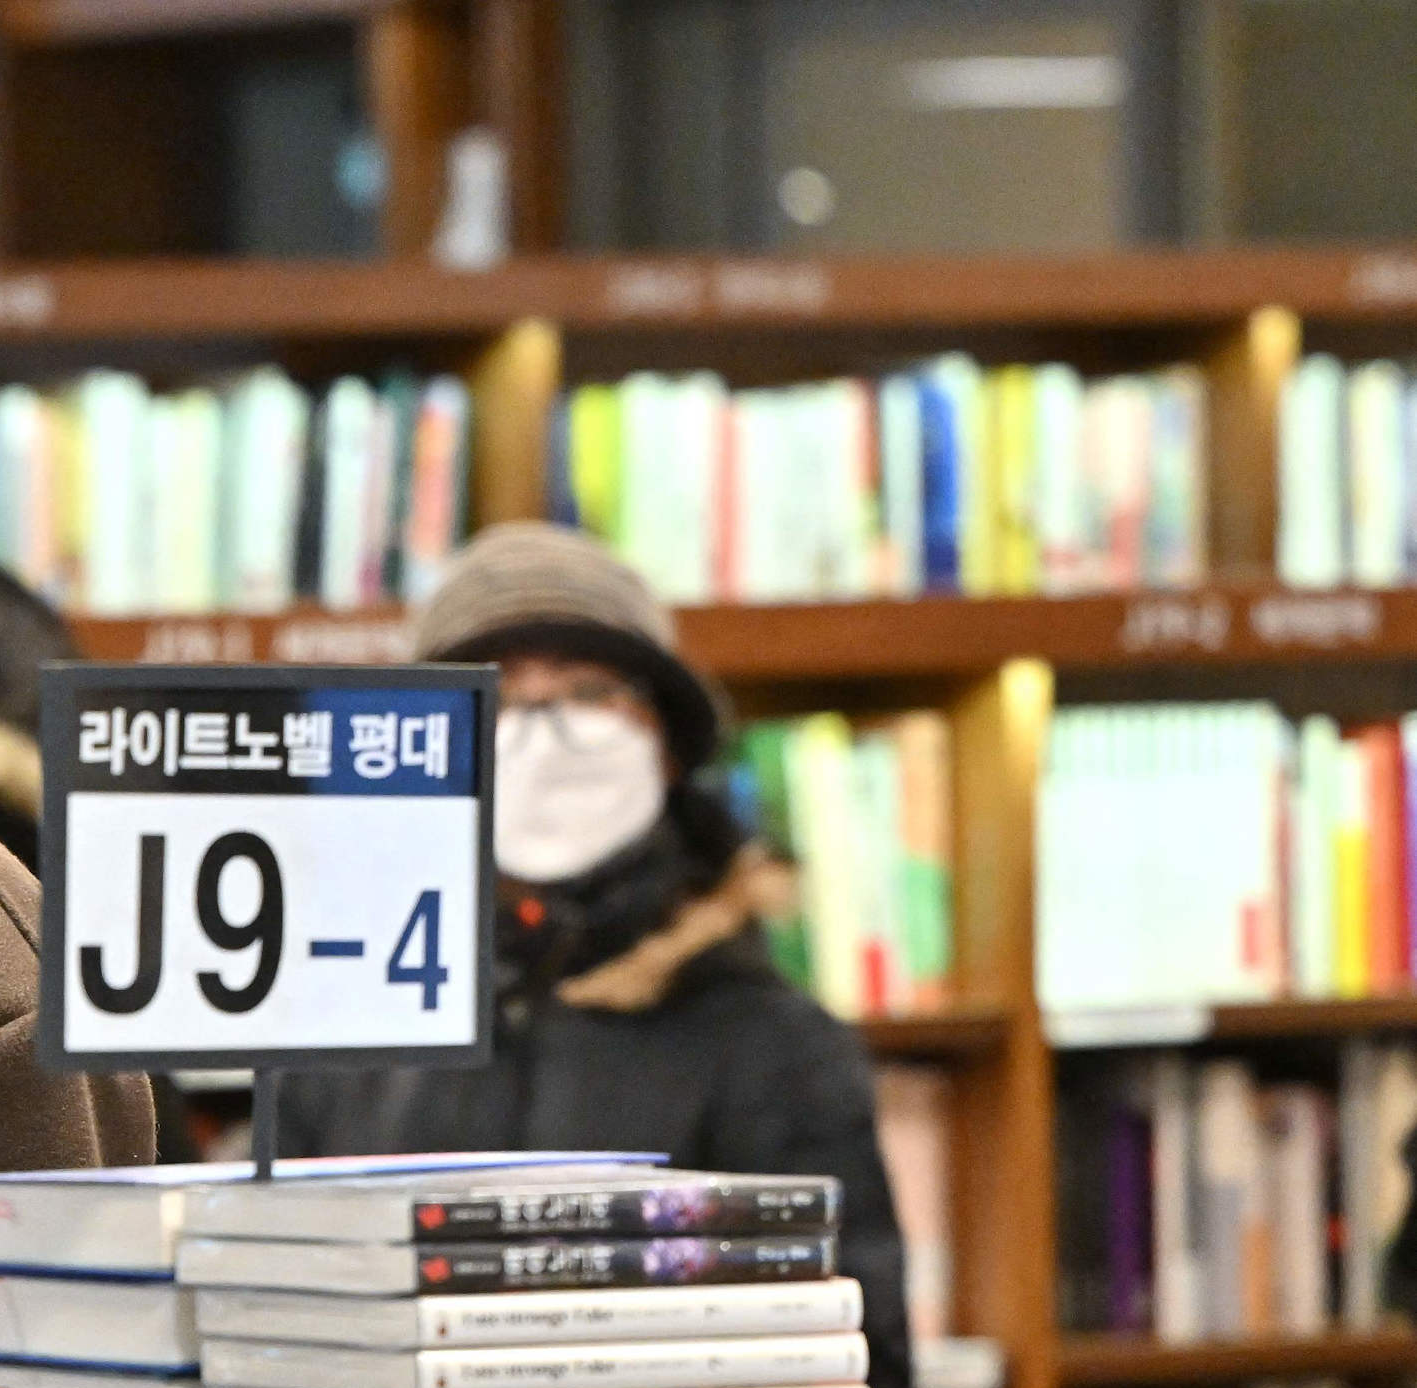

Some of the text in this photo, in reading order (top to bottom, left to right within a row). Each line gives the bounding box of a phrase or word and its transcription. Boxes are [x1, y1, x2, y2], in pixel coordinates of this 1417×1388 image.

[79, 708, 450, 779] 라이트노벨 평대
[79, 832, 449, 1015] J9-4
